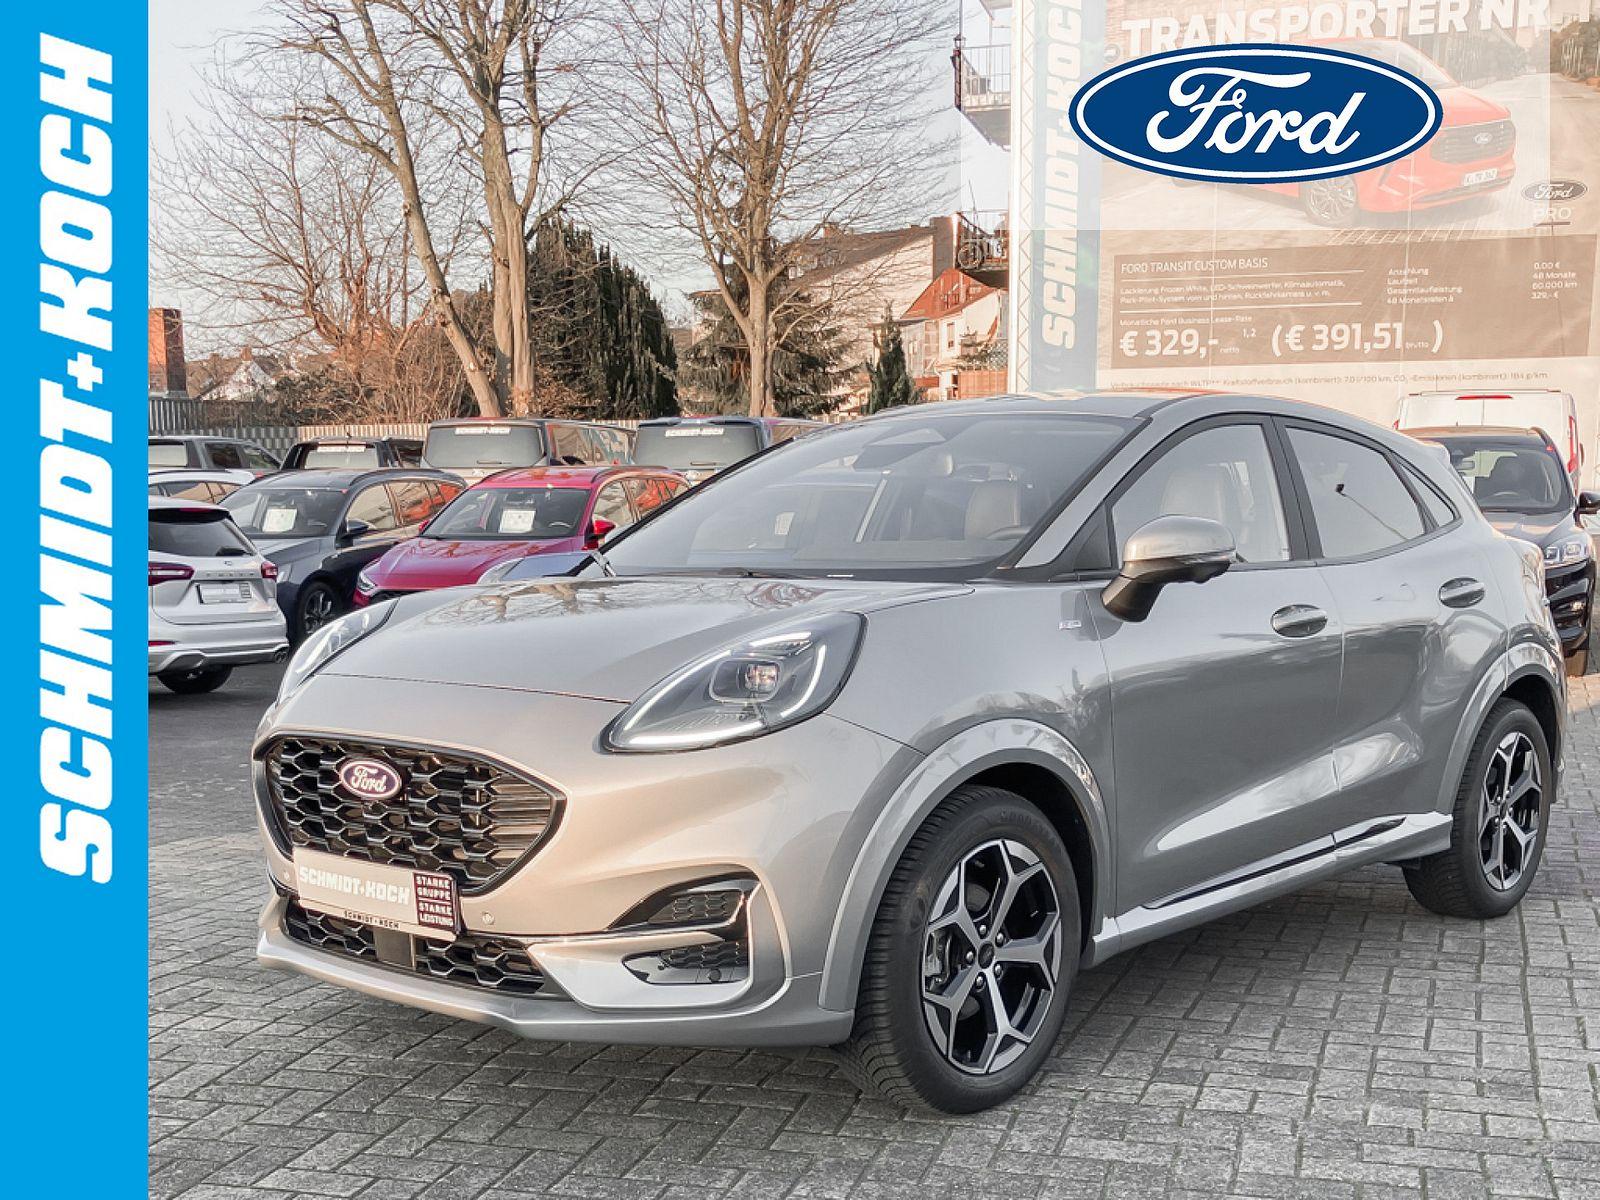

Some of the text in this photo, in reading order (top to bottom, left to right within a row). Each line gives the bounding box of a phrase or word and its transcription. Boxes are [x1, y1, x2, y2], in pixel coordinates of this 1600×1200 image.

[1121, 0, 1469, 57] TRANSPORTER
[1041, 0, 1082, 350] SCHMIDT+KOC
[1534, 184, 1573, 199] Ford
[1534, 207, 1571, 221] PRO
[1121, 257, 1268, 274] FORD TRANSIT CUSTOM BASIS
[1545, 271, 1576, 279] Monate
[1564, 280, 1578, 288] km
[1120, 331, 1138, 357] €
[1144, 328, 1219, 359] 329,-
[1311, 322, 1403, 354] 391,51
[351, 766, 387, 793] Ford
[416, 876, 451, 888] STARKE
[417, 887, 452, 900] GRUPPE
[418, 902, 453, 915] STARKE
